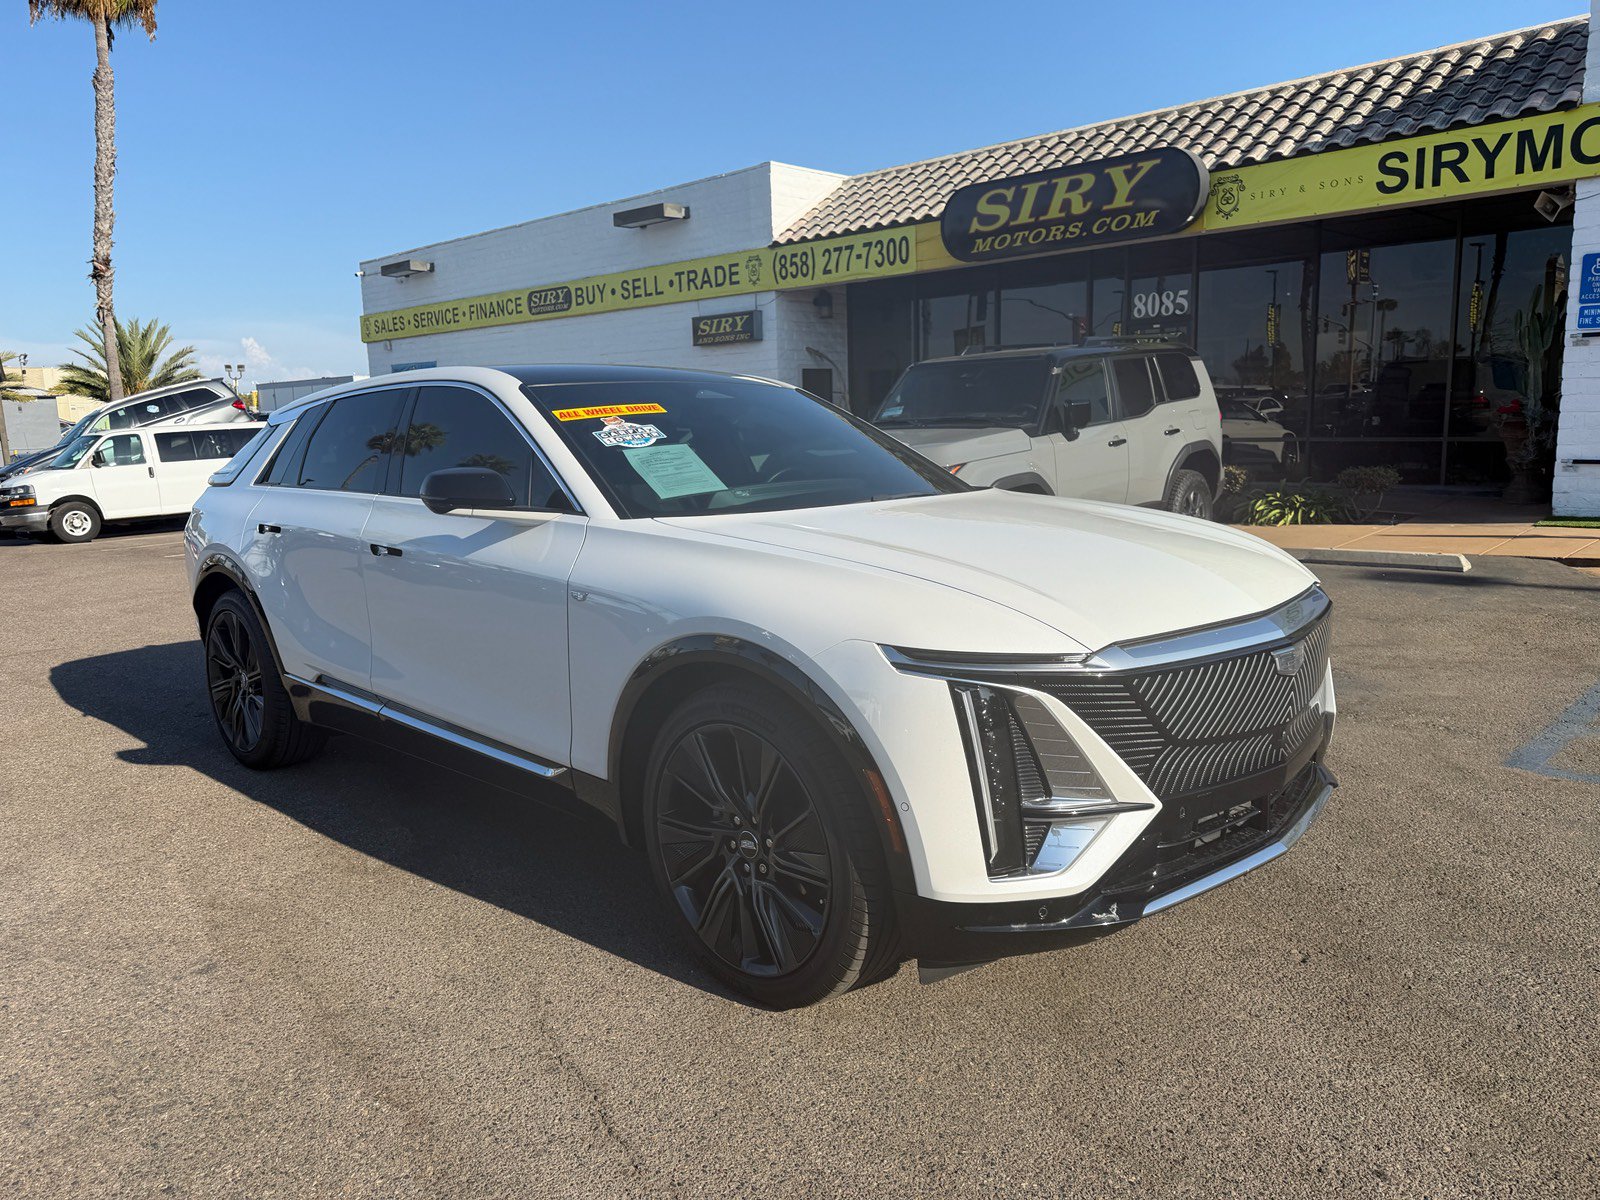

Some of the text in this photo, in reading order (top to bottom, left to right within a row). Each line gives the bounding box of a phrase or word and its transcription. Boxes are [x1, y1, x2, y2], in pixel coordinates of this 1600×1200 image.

[968, 158, 1162, 234] SIRY
[1250, 175, 1365, 201] SIRY & SONS
[971, 209, 1160, 254] MOTORS.COM
[772, 235, 910, 284] (858) 277-7300
[531, 288, 568, 307] SIRY
[574, 262, 740, 306] BUY SELL TRADE
[374, 297, 523, 334] SALES SERVICE FINANCE
[1133, 289, 1189, 318] 8085
[697, 315, 750, 336] SIRY
[698, 336, 714, 344] AND
[558, 404, 660, 419] ALL WHEEL DRIVE
